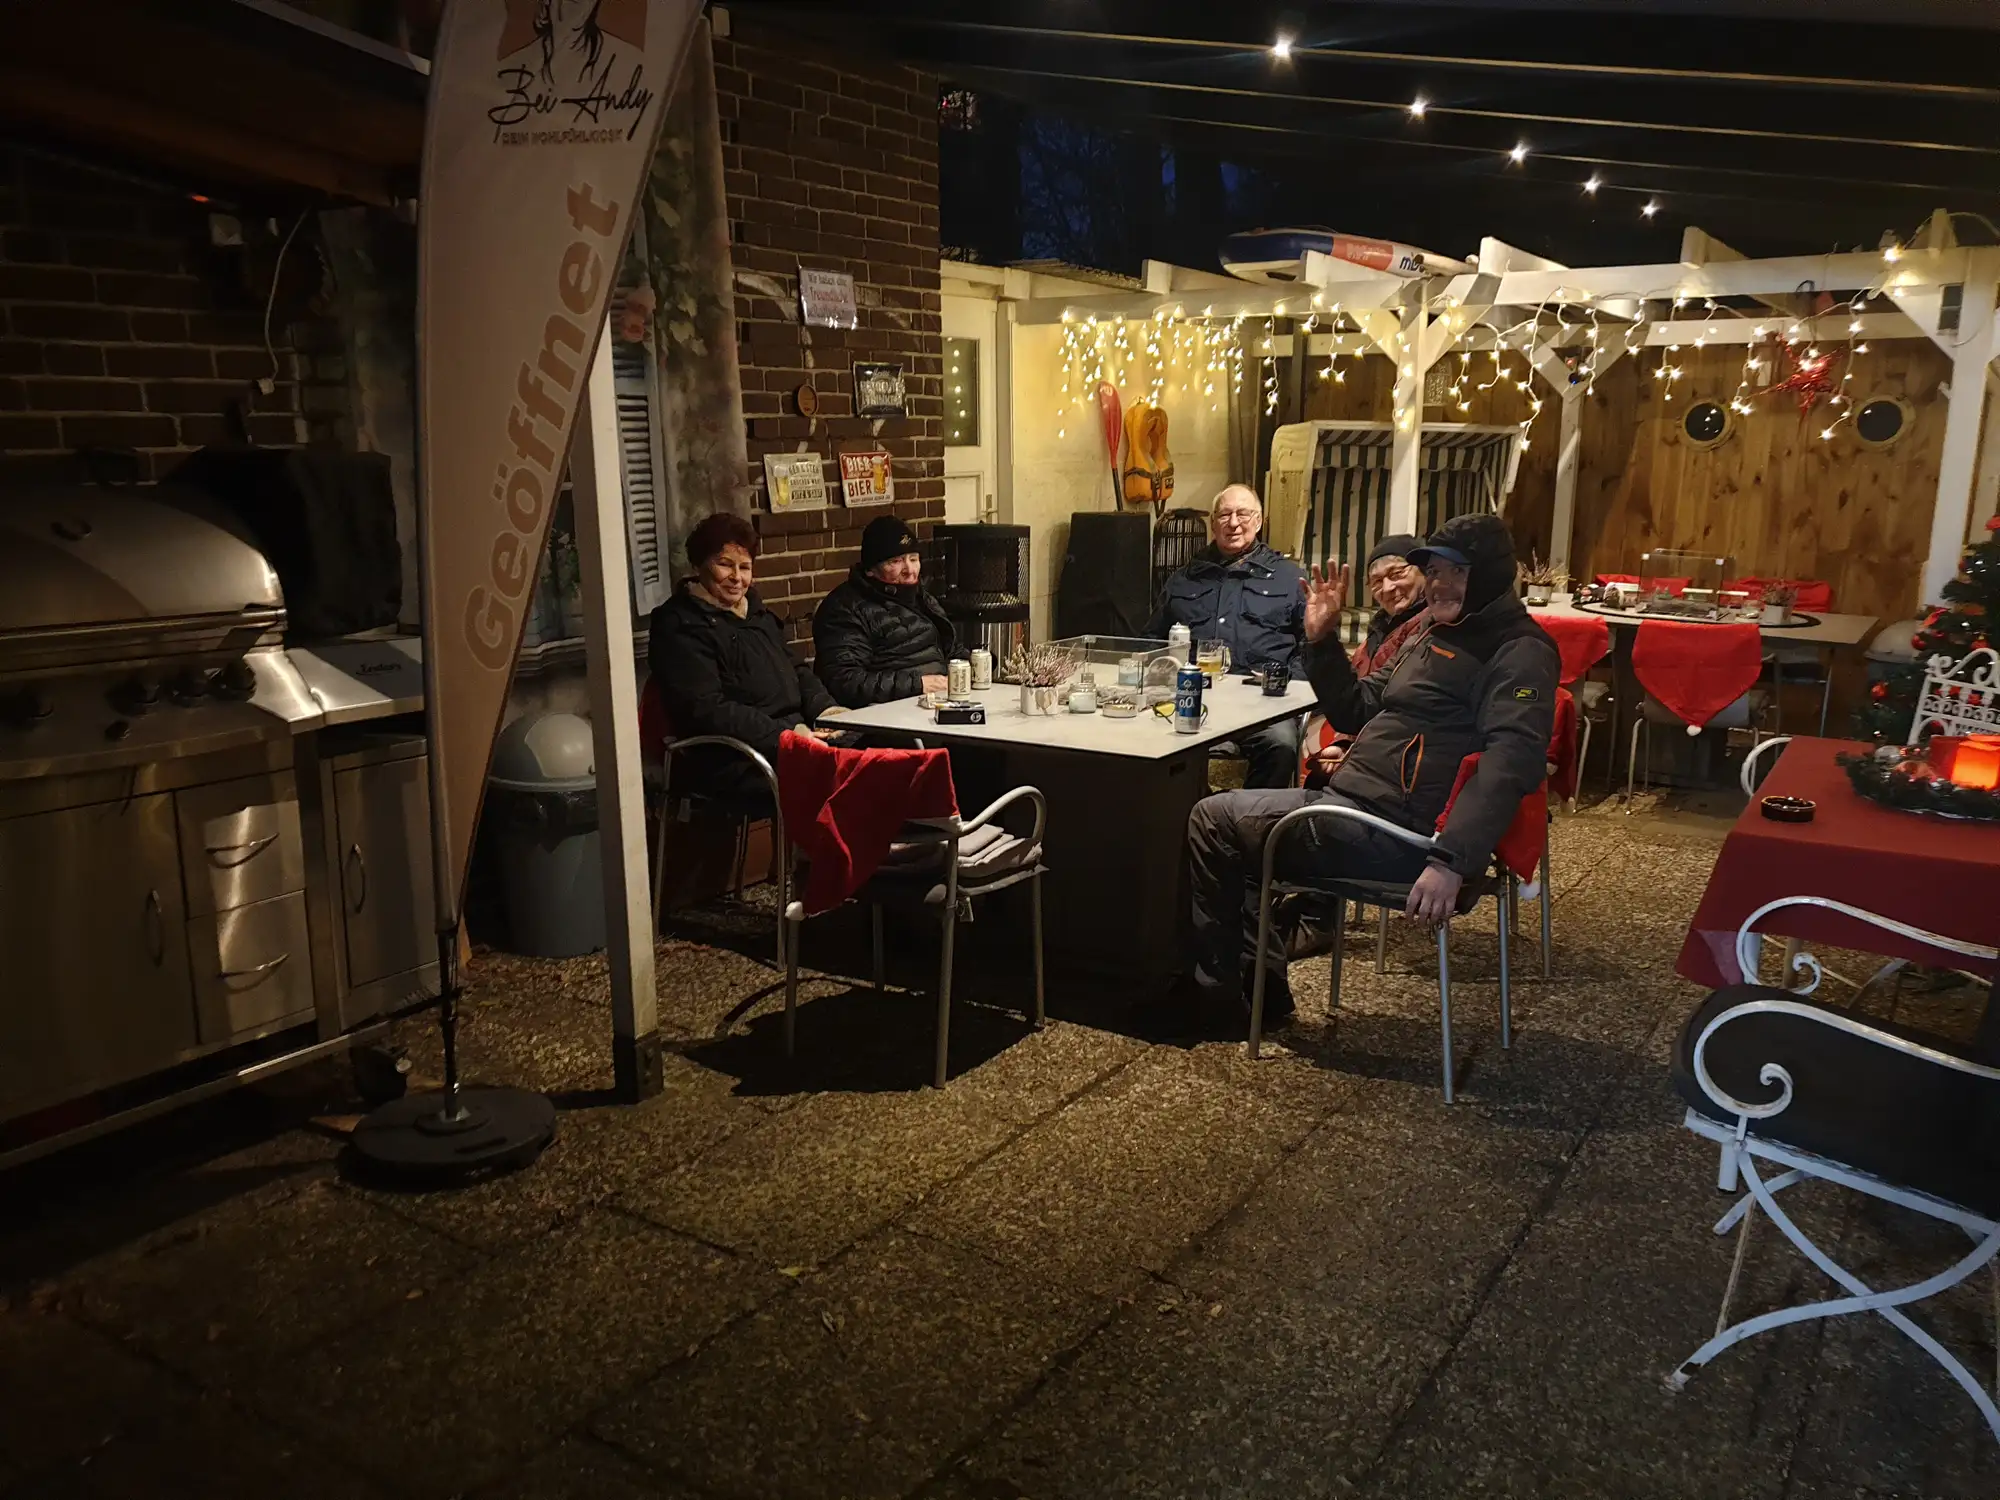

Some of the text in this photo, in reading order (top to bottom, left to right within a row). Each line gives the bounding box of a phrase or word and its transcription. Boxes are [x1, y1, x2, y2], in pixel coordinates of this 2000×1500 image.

[488, 53, 653, 143] Bei Andy
[463, 181, 619, 672] Geöffnet
[846, 455, 871, 472] BIER
[848, 480, 872, 497] BIER
